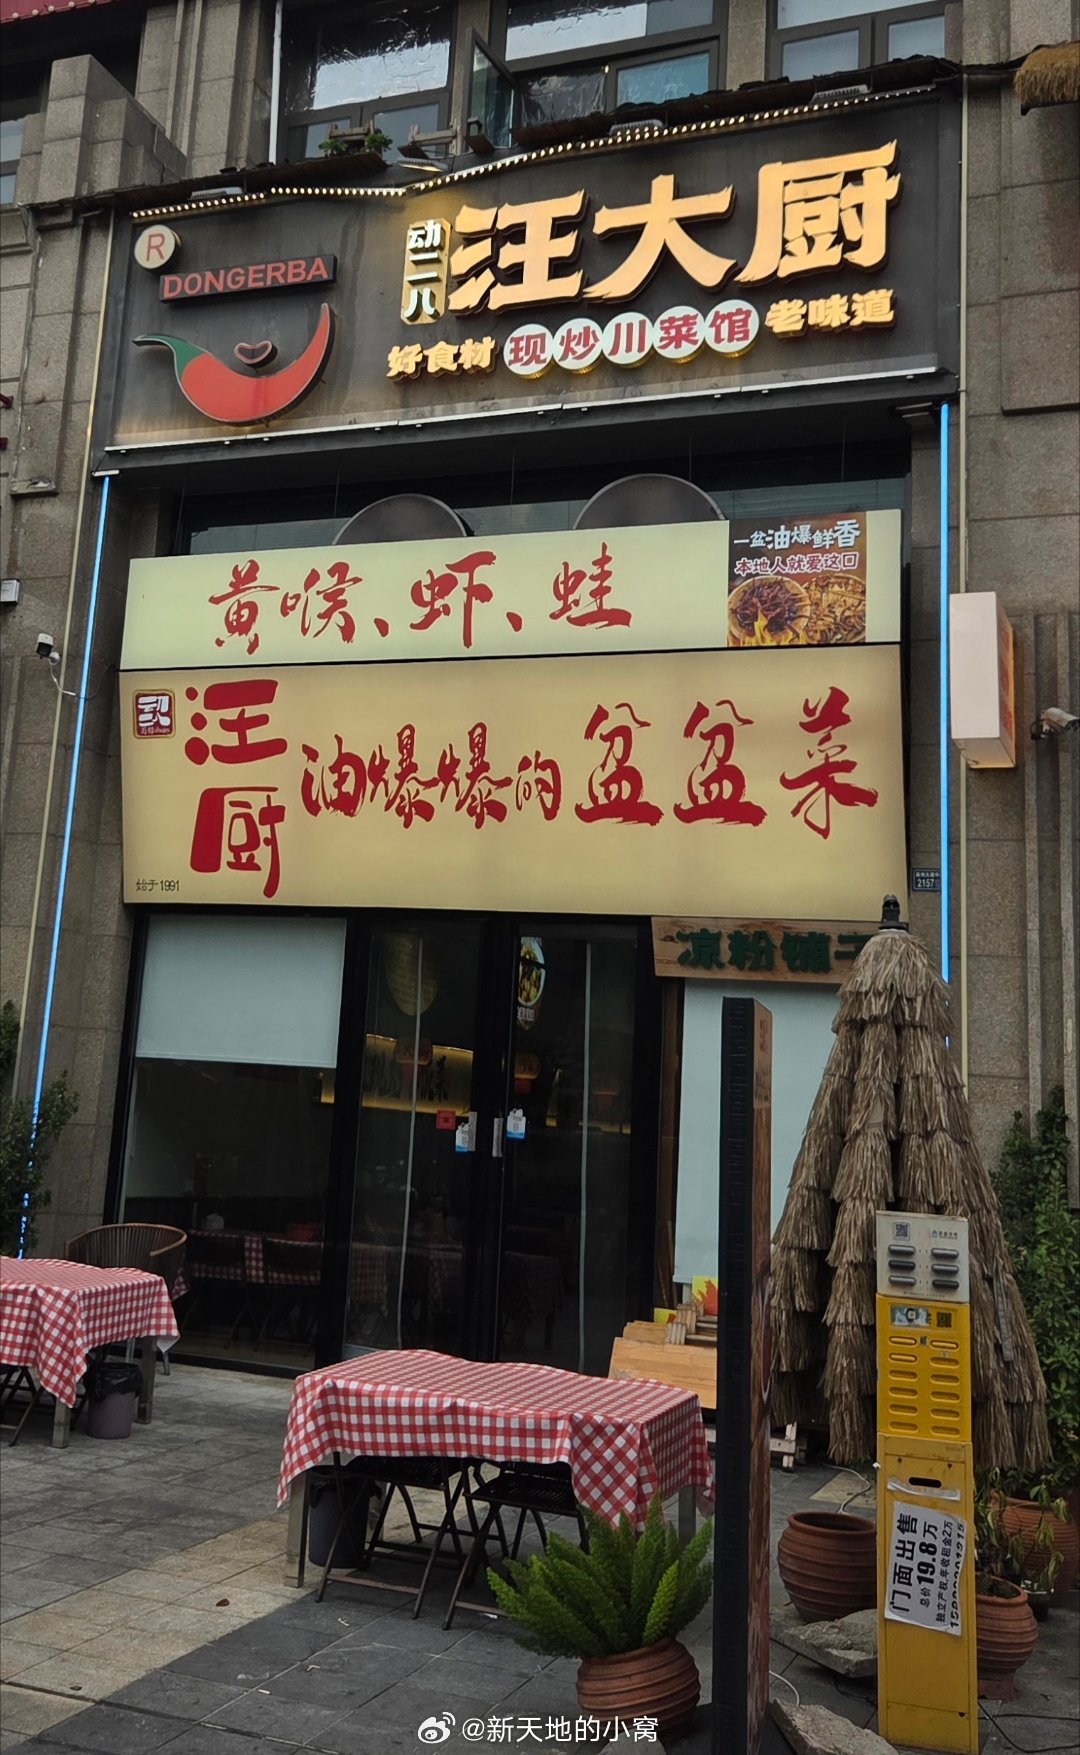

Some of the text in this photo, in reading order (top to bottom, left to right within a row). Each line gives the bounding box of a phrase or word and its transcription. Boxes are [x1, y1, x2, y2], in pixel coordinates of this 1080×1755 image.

[403, 219, 443, 319] 动二八
[450, 139, 901, 311] 汪大厨
[162, 256, 329, 300] DONGERBA
[386, 288, 895, 378] 好食材 现炒川菜馆 老味道
[733, 519, 861, 550] 一盆油爆鲜香
[734, 552, 860, 577] 本地人就爱这口
[184, 679, 288, 898] 汪厨
[301, 686, 879, 840] 油爆爆的盆盆菜
[890, 1512, 919, 1613] 门面出售
